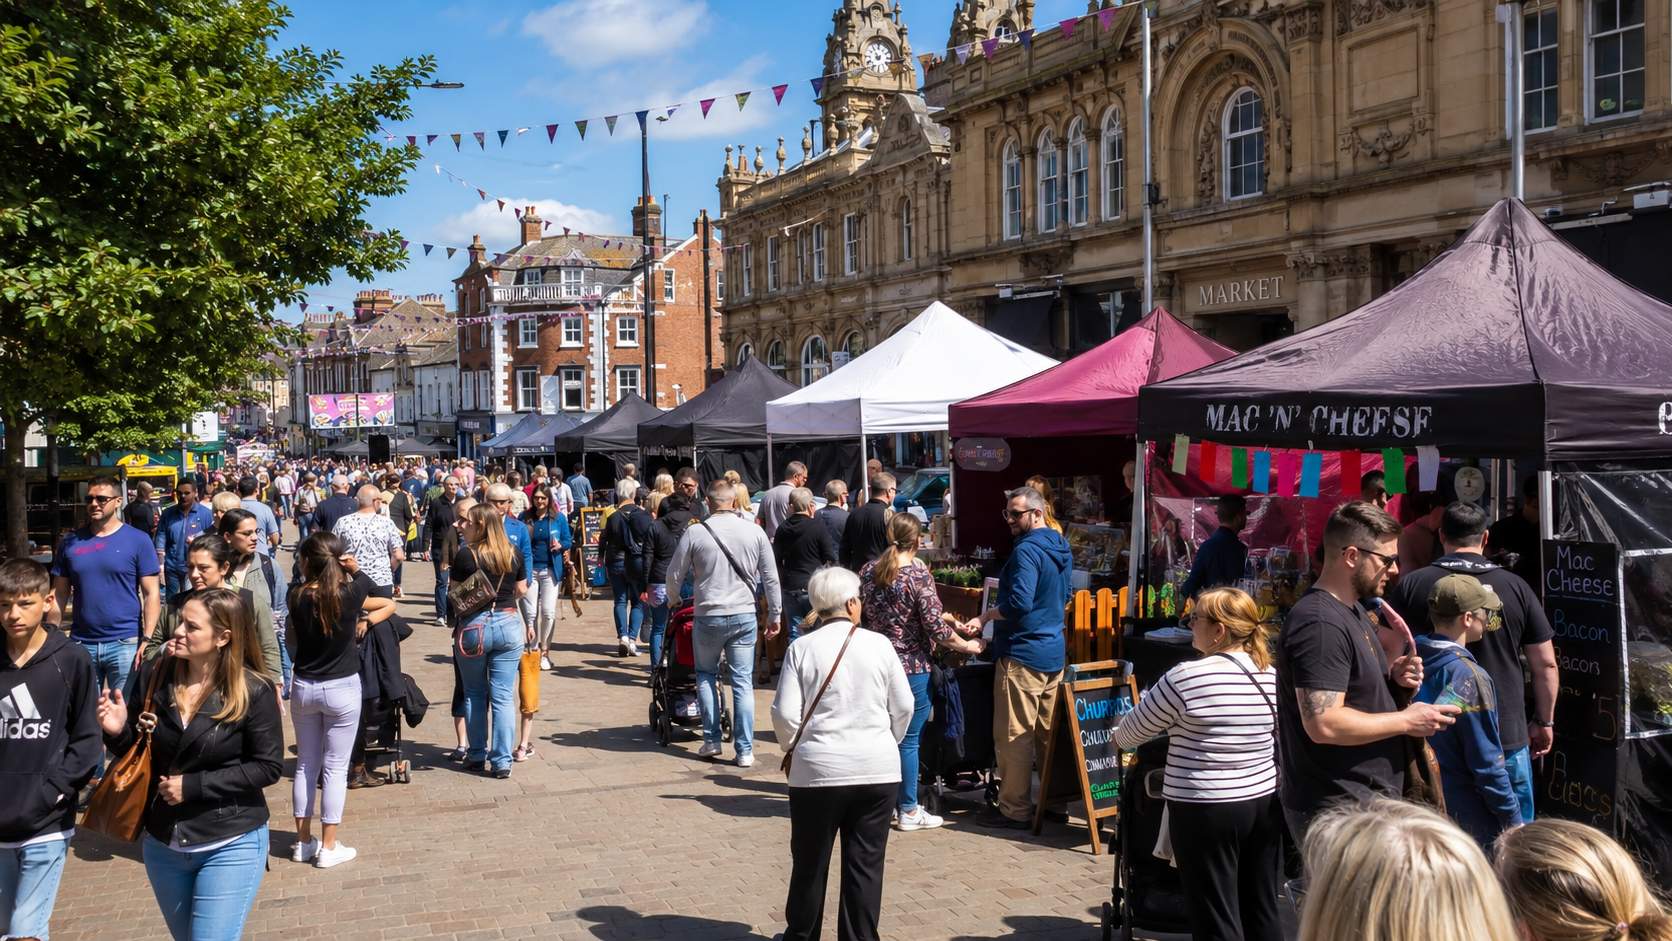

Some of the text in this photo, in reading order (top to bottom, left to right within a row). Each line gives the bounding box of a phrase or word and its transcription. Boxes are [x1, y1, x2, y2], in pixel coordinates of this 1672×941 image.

[1199, 276, 1284, 306] MARKET
[1205, 403, 1261, 432] MAC
[1556, 545, 1595, 571] Mac
[1553, 608, 1610, 643] Bacon
